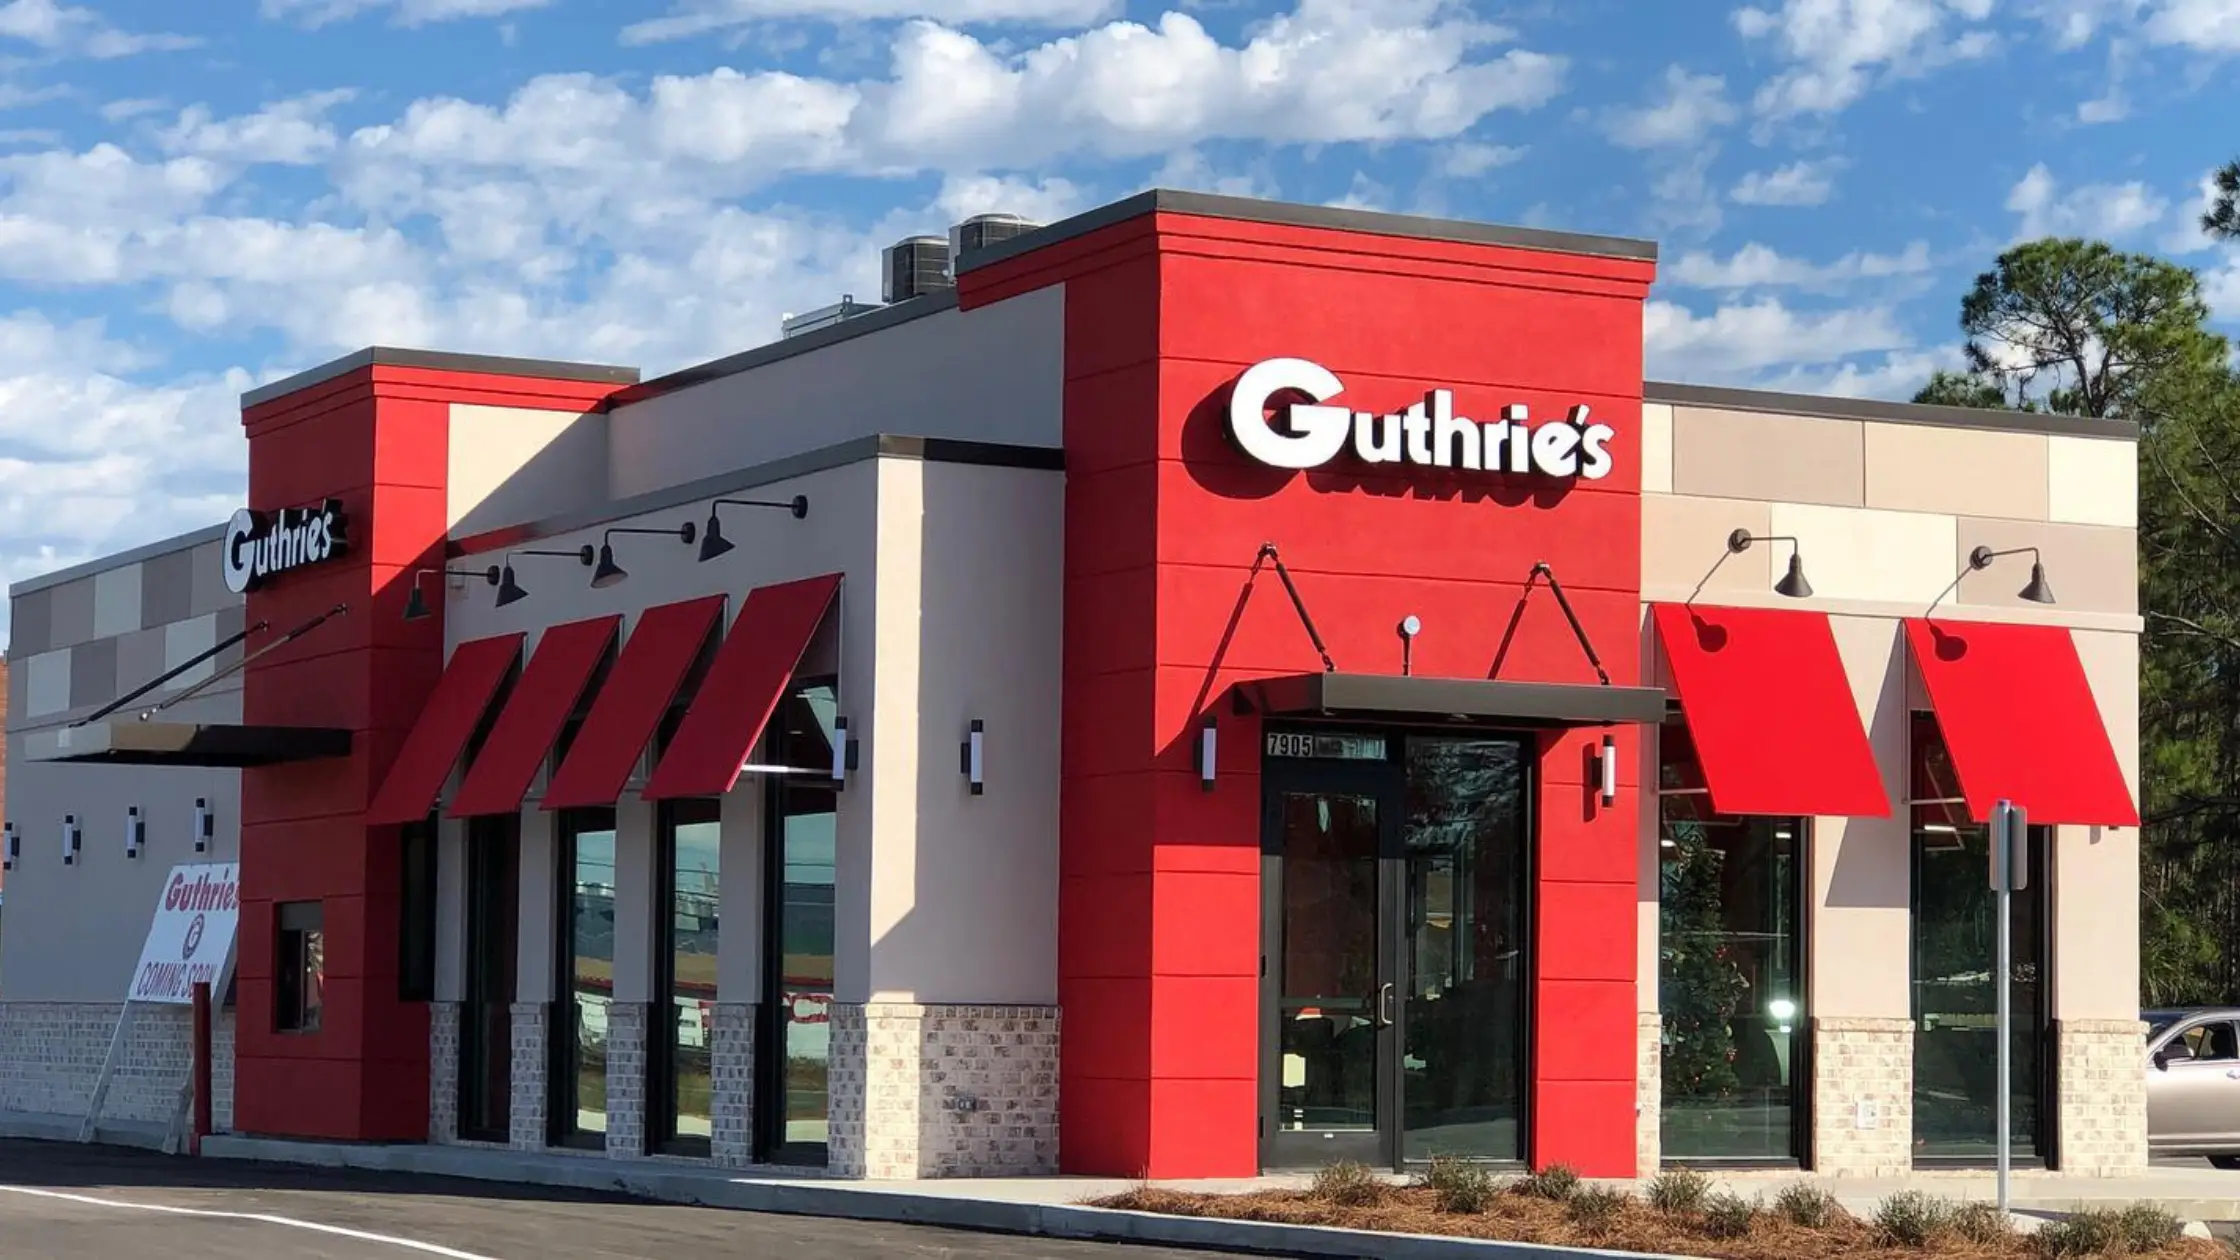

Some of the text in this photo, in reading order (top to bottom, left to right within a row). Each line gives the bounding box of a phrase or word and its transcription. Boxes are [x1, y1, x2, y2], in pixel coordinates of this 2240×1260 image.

[1230, 357, 1616, 480] Guthrie's
[224, 498, 333, 593] Guthrie's
[1268, 734, 1313, 756] 7905
[136, 961, 187, 998] COMING
